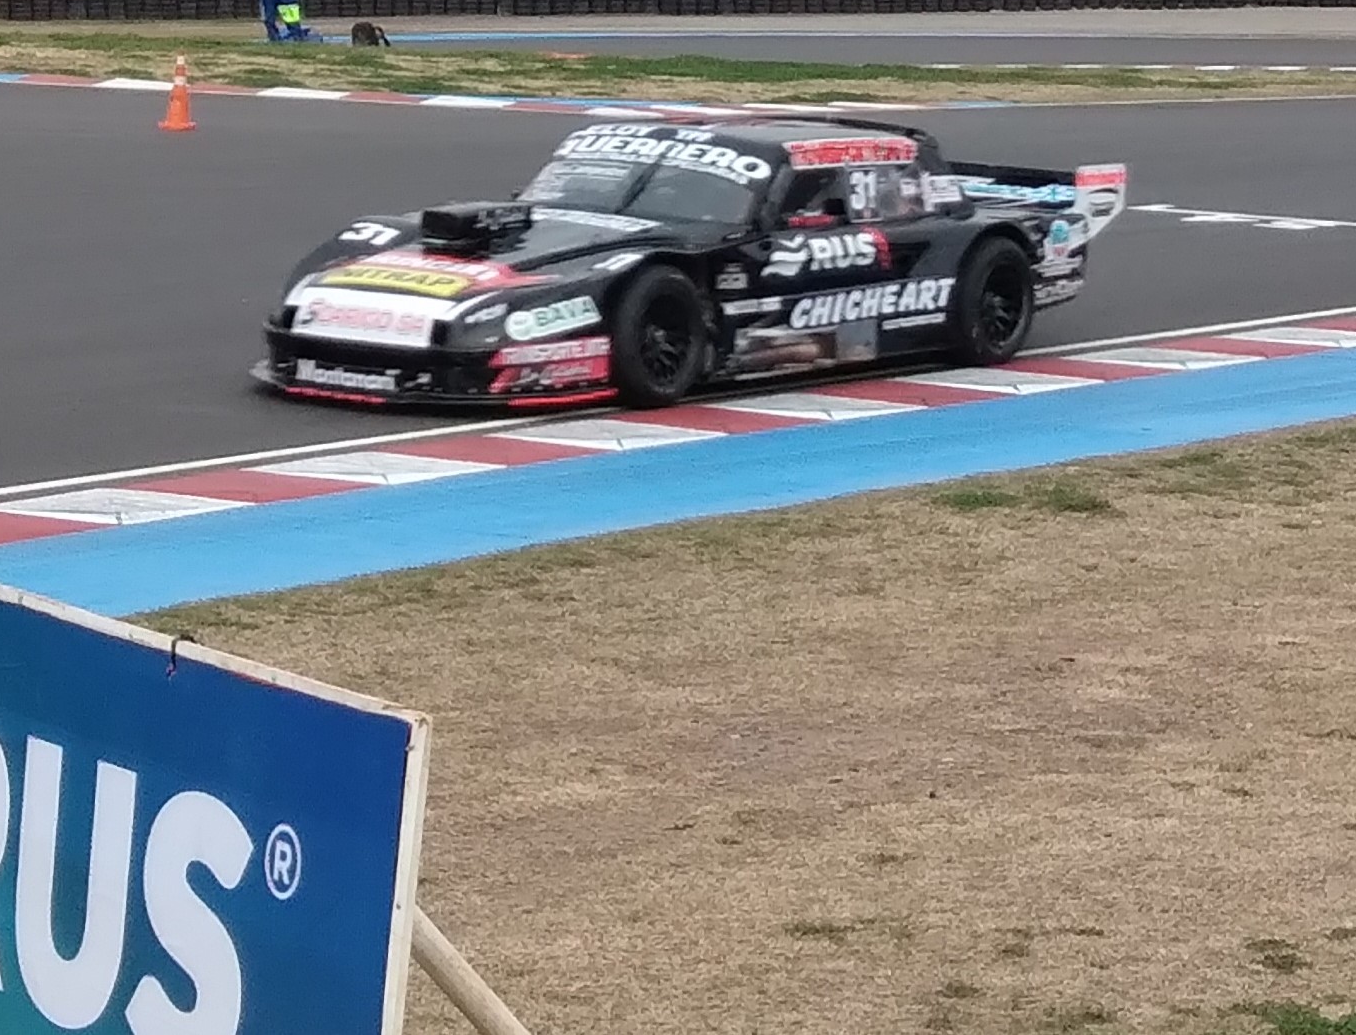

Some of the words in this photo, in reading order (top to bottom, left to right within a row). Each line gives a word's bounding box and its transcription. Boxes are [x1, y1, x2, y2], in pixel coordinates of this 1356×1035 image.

[850, 171, 878, 210] 31
[806, 232, 878, 270] RUS
[789, 277, 957, 328] CHICHEART
